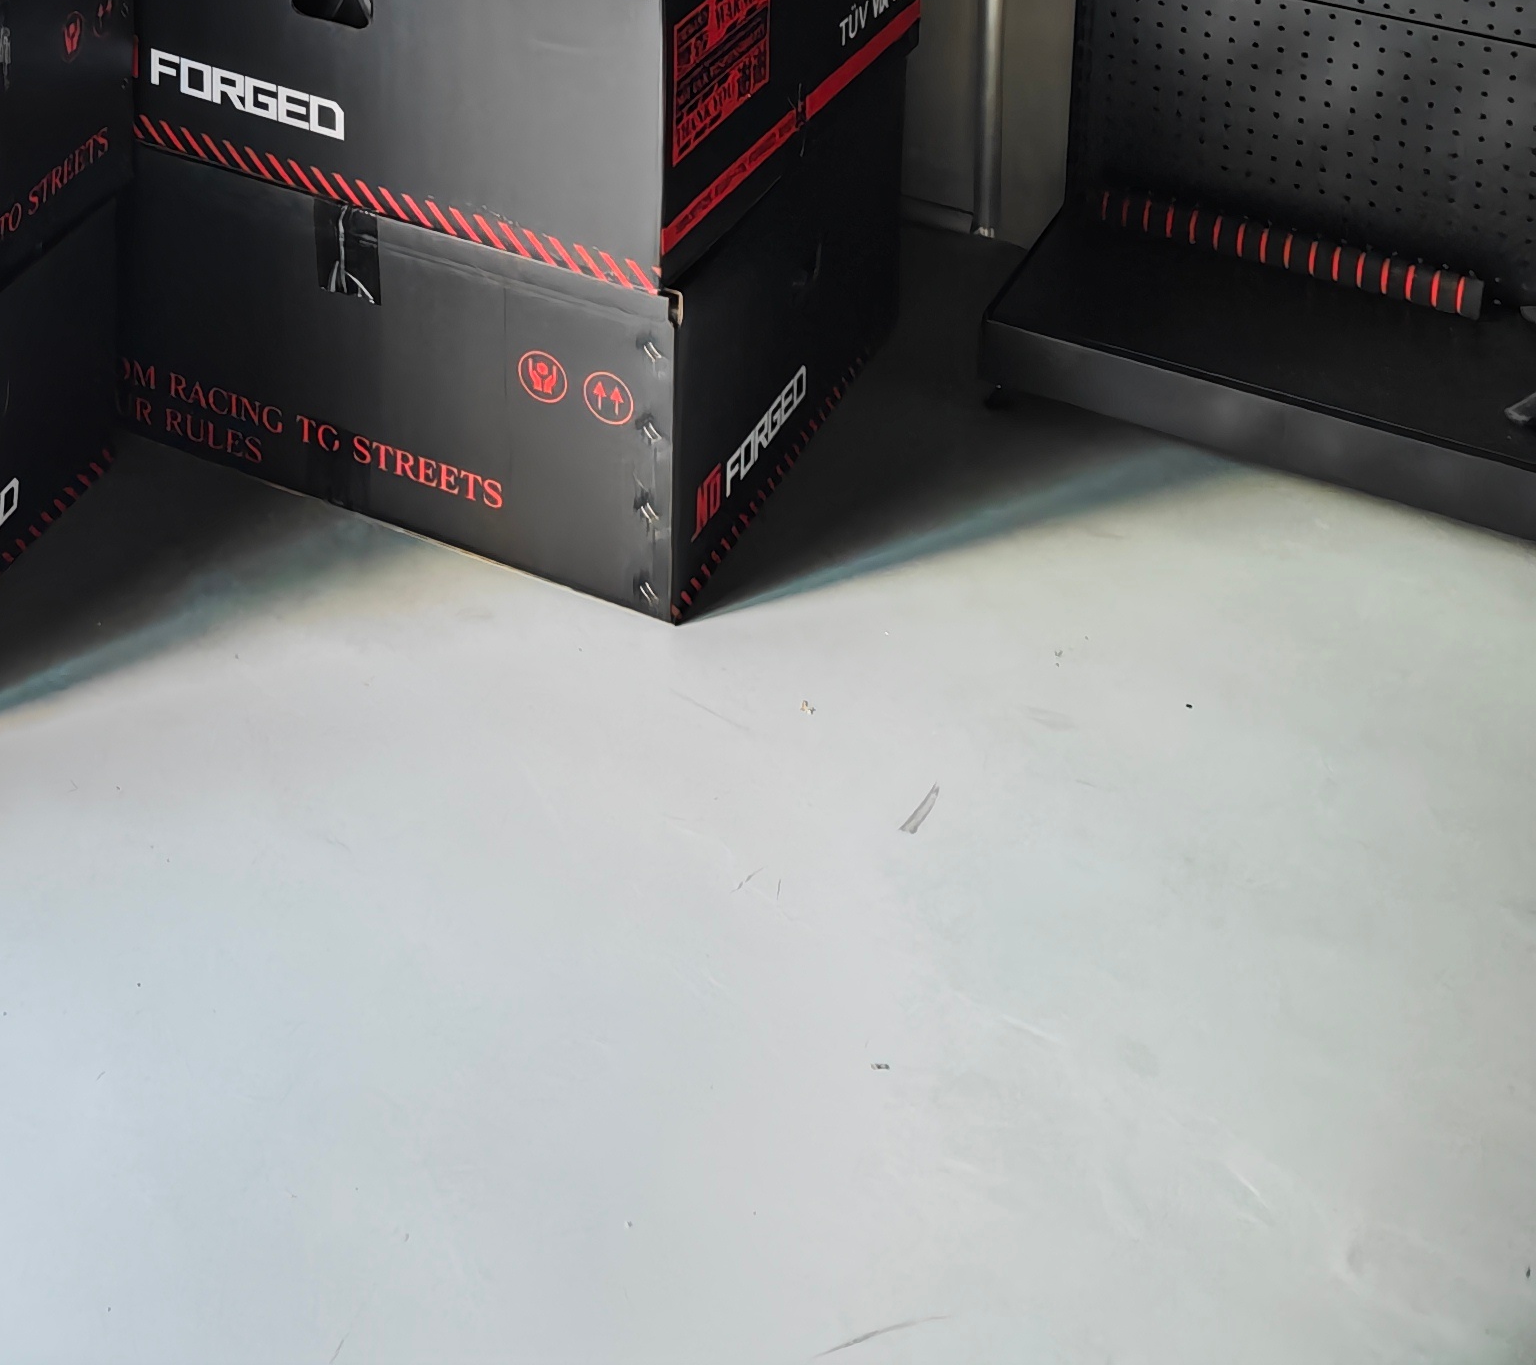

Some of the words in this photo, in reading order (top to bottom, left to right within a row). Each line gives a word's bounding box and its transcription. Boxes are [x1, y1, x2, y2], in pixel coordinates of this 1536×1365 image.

[839, 2, 869, 46] TÜV
[150, 48, 345, 141] FORGED
[27, 126, 110, 217] STREETS
[165, 407, 263, 464] RULES
[169, 372, 283, 435] RACING
[297, 415, 340, 452] TO
[353, 435, 504, 510] STREETS
[726, 364, 807, 498] FORGED
